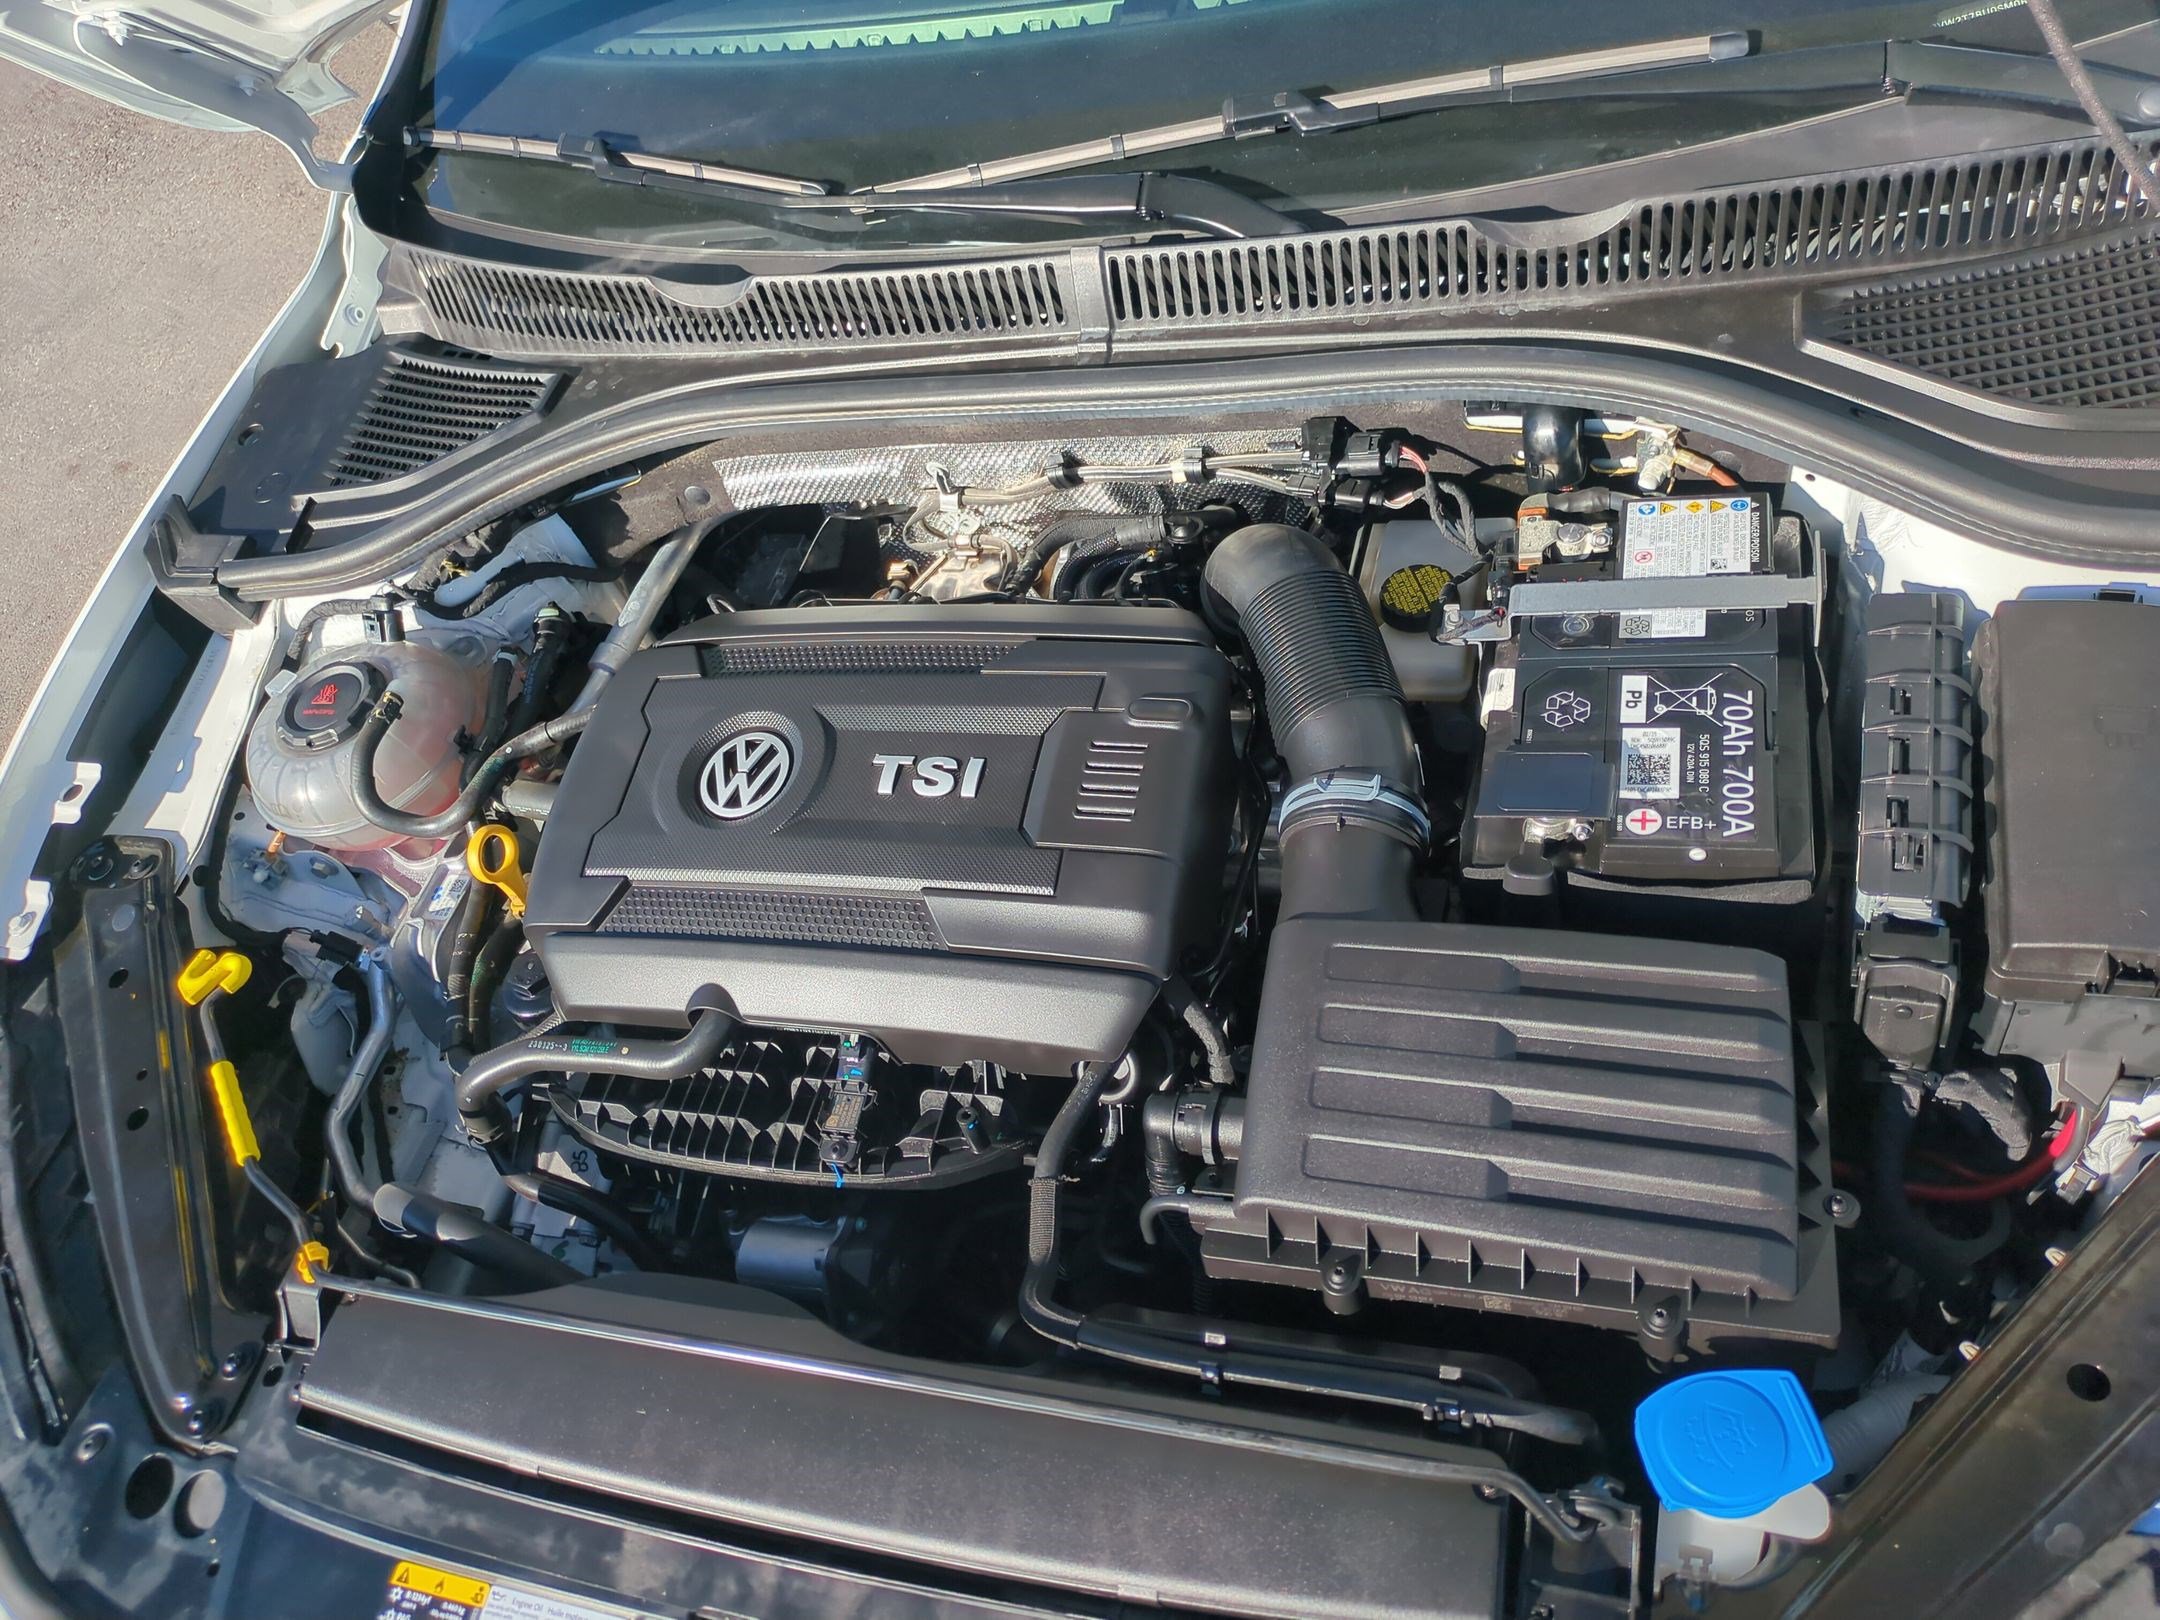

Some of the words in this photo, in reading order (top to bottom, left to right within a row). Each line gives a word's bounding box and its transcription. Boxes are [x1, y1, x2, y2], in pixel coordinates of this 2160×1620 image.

[1751, 511, 1760, 563] DANGER/POISON
[1626, 690, 1642, 709] Pb
[1723, 690, 1754, 755] 70Ah
[1699, 734, 1710, 751] 5QS
[1699, 752, 1710, 767] 915
[872, 753, 986, 798] TSI
[1686, 771, 1695, 783] DIN
[1699, 769, 1710, 784] 089
[1722, 766, 1755, 837] 700A
[1666, 816, 1717, 830] EFB+
